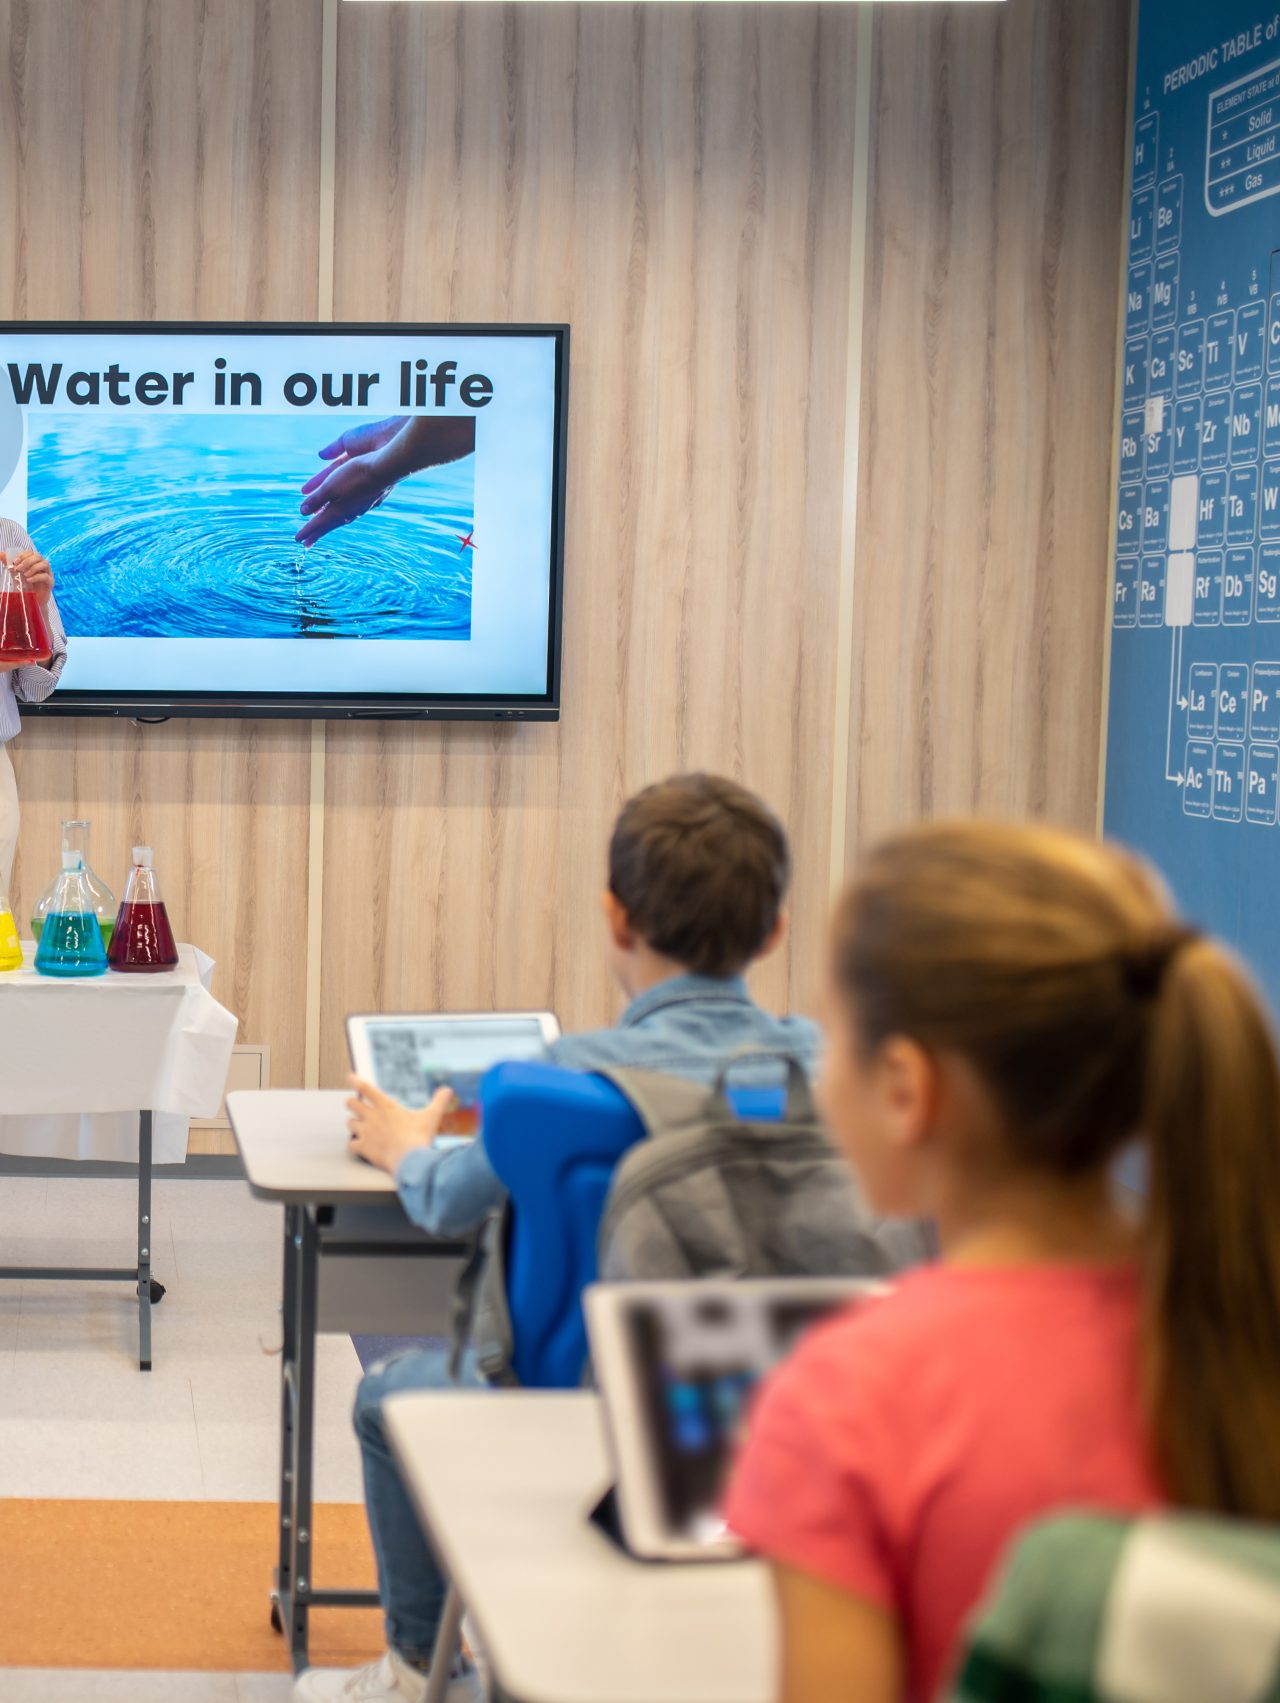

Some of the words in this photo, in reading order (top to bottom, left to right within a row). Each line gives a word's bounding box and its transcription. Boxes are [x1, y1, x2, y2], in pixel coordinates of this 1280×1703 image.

[1164, 48, 1218, 95] PERIODIC
[1222, 24, 1262, 63] TABLE
[1265, 14, 1280, 41] of
[1217, 91, 1246, 114] ELEMENT
[1247, 80, 1267, 99] STATE
[1248, 108, 1273, 132] Solid
[1135, 143, 1144, 166] H
[1246, 136, 1276, 162] Liquid
[1244, 174, 1263, 191] Gas
[1131, 216, 1142, 240] Li
[1158, 206, 1173, 229] Be
[1127, 292, 1143, 313] Na
[1154, 281, 1171, 307] Mg
[1238, 332, 1248, 356] V
[1270, 321, 1280, 345] C
[1178, 349, 1194, 372] Sc
[1206, 340, 1219, 364] Ti
[1125, 363, 1135, 386] K
[1151, 357, 1166, 379] Ca
[8, 363, 195, 406] Water
[215, 358, 262, 406] in
[284, 373, 380, 407] our
[400, 360, 494, 408] life
[1232, 413, 1251, 437] Nb
[1266, 403, 1280, 428] M
[1147, 432, 1161, 453] Sr
[1176, 426, 1185, 448] Y
[1202, 420, 1217, 443] Zr
[1121, 437, 1137, 458] Rb
[1199, 498, 1214, 521] Hf
[1230, 495, 1244, 517] Ta
[1264, 487, 1279, 511] W
[1118, 510, 1133, 531] Cs
[1144, 507, 1160, 528] Ba
[1115, 582, 1128, 602] Fr
[1141, 580, 1156, 602] Ra
[1195, 576, 1210, 599] Rf
[1224, 575, 1243, 597] Db
[1258, 570, 1277, 599] Sg
[1190, 689, 1205, 712] La
[1219, 690, 1237, 714] Ce
[1253, 689, 1269, 713] Pr
[1185, 766, 1203, 789] Ac
[1216, 769, 1232, 793] Th
[1249, 770, 1266, 795] Pa
